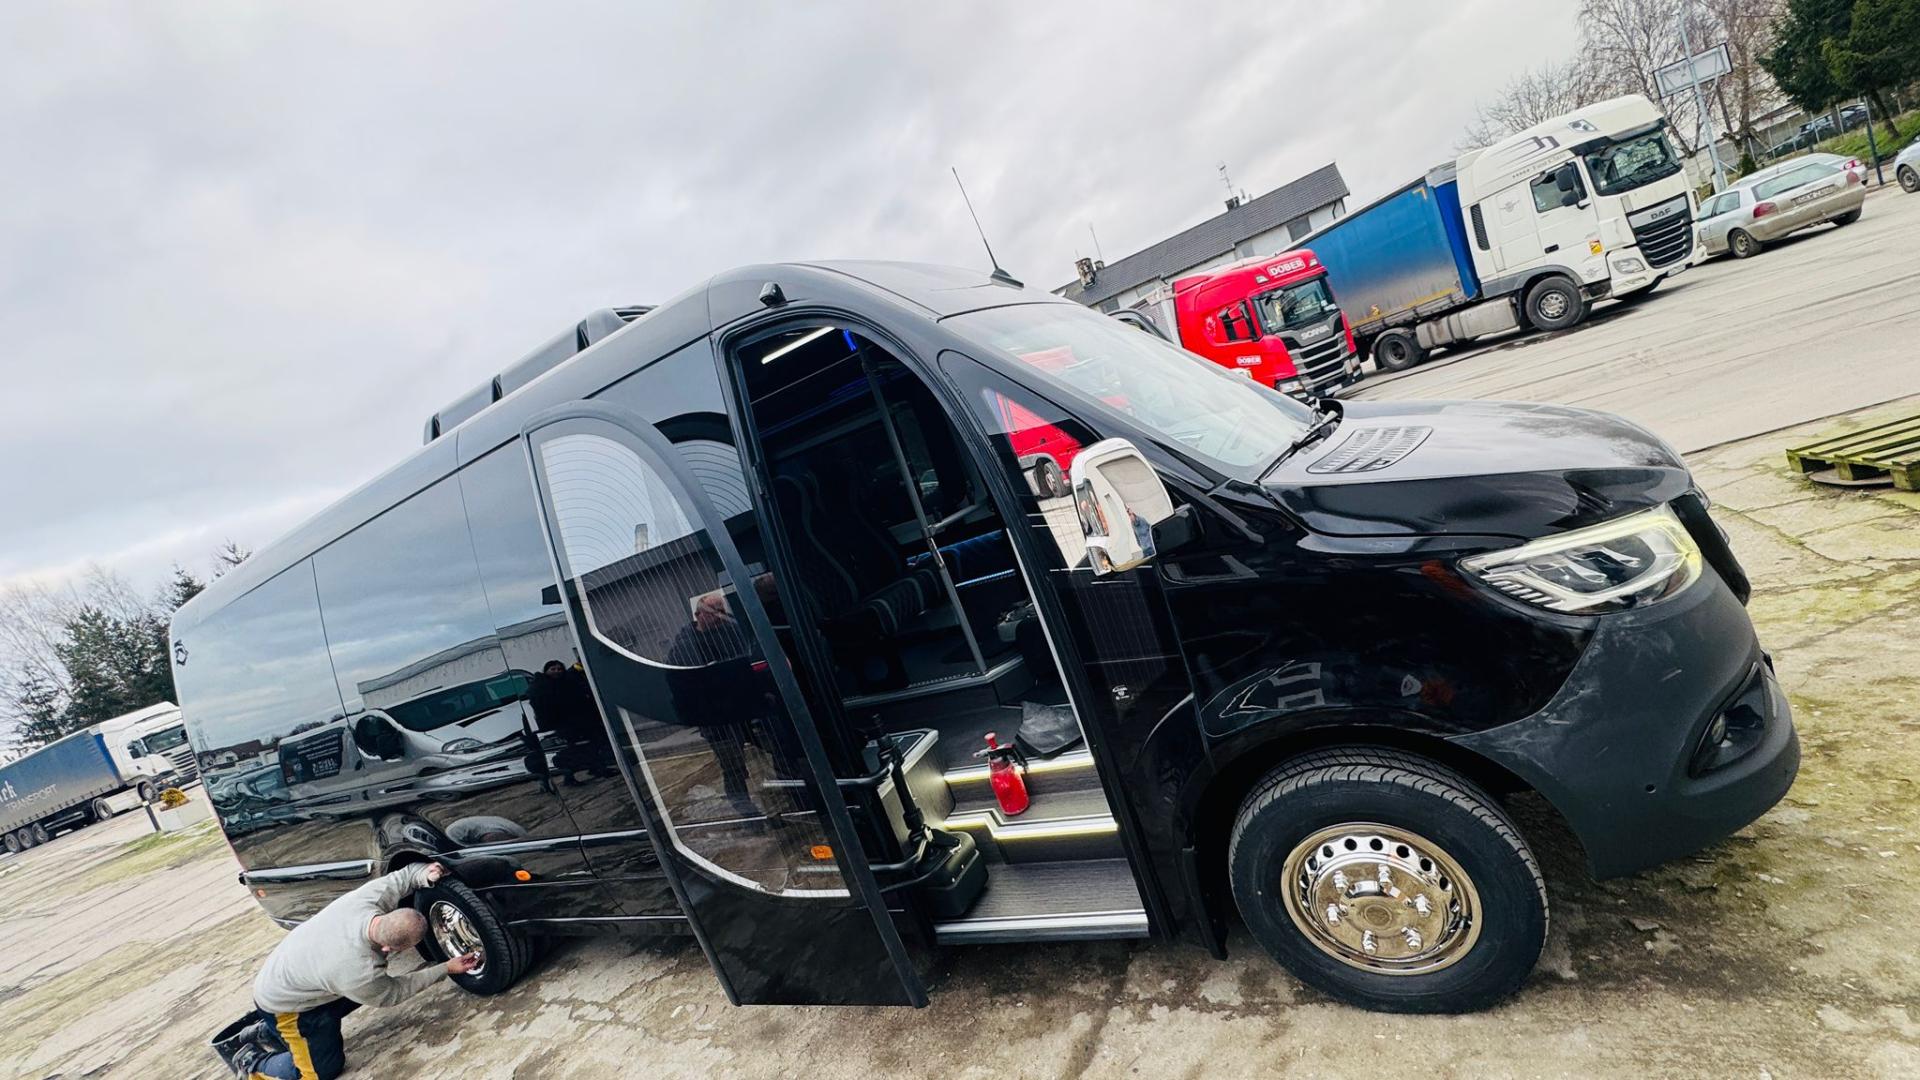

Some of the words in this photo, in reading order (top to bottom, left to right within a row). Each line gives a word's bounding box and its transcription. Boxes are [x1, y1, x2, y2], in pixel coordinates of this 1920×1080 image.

[1651, 207, 1672, 219] DAF
[1269, 258, 1304, 276] DOBER
[1301, 325, 1331, 340] SCANIA
[5, 783, 58, 811] TRANSPORT
